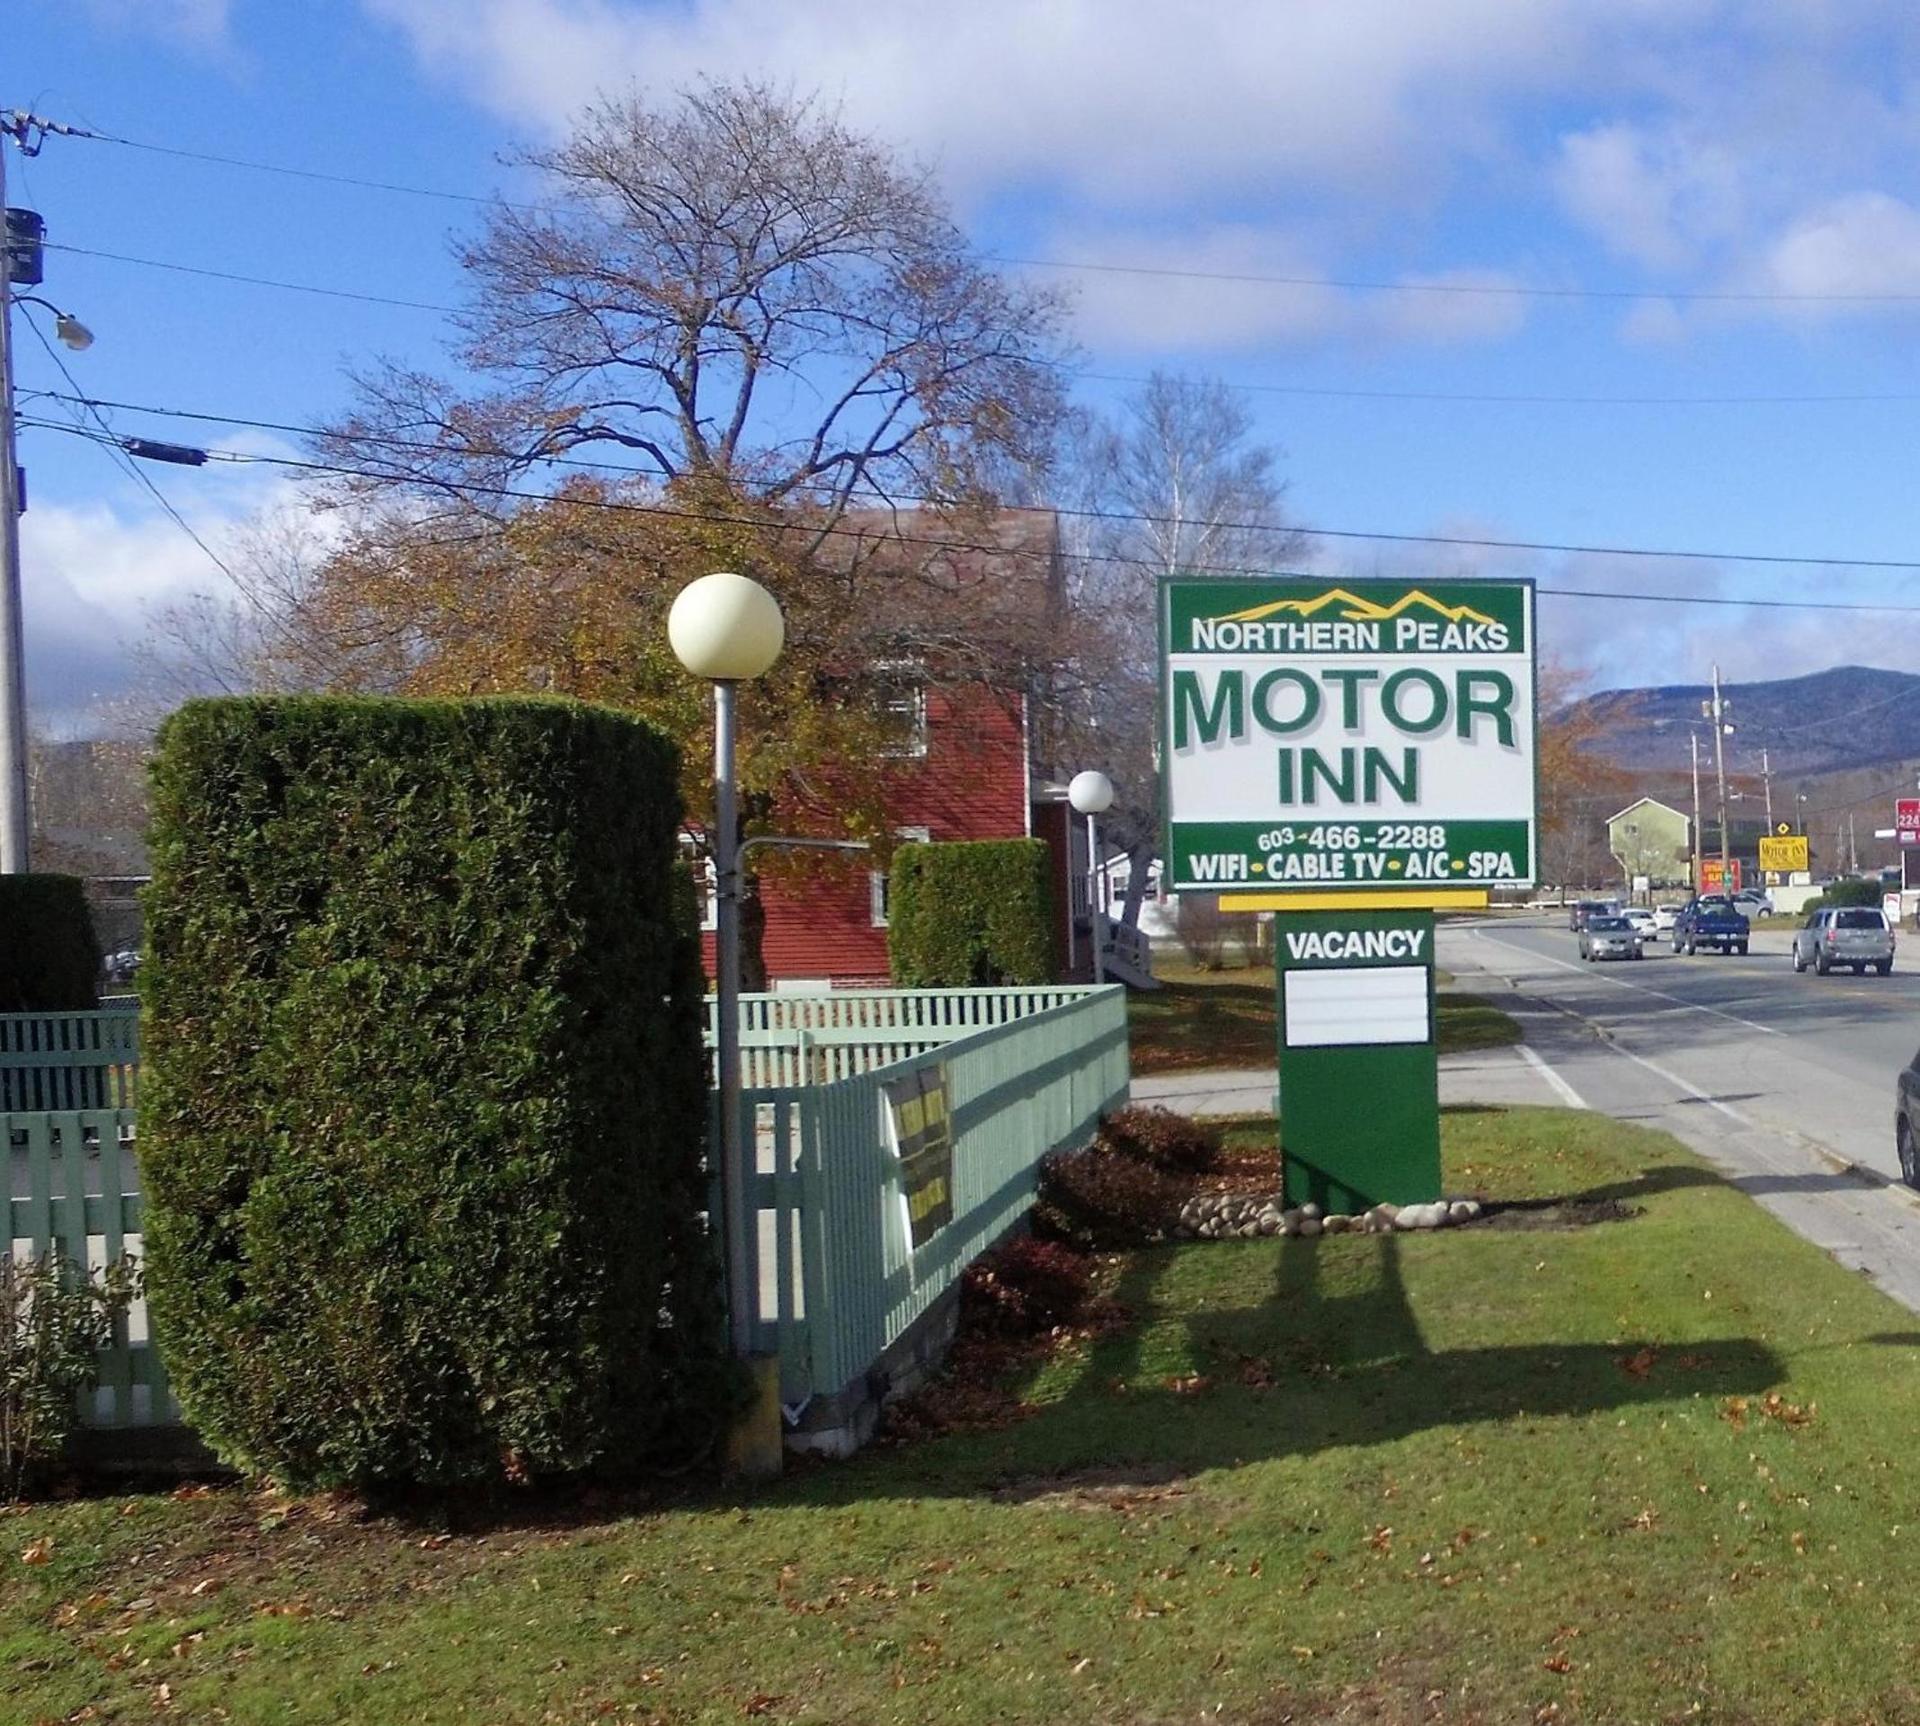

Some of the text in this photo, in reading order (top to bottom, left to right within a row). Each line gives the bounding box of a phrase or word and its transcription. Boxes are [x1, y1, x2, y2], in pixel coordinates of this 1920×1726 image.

[1192, 617, 1510, 651] NORTHERN PEAKS
[1172, 667, 1517, 751] MOTOR
[1278, 747, 1419, 804] INN
[1189, 850, 1516, 880] WIFI CABLE TV A/C SPA
[1286, 929, 1425, 960] VACANCY
